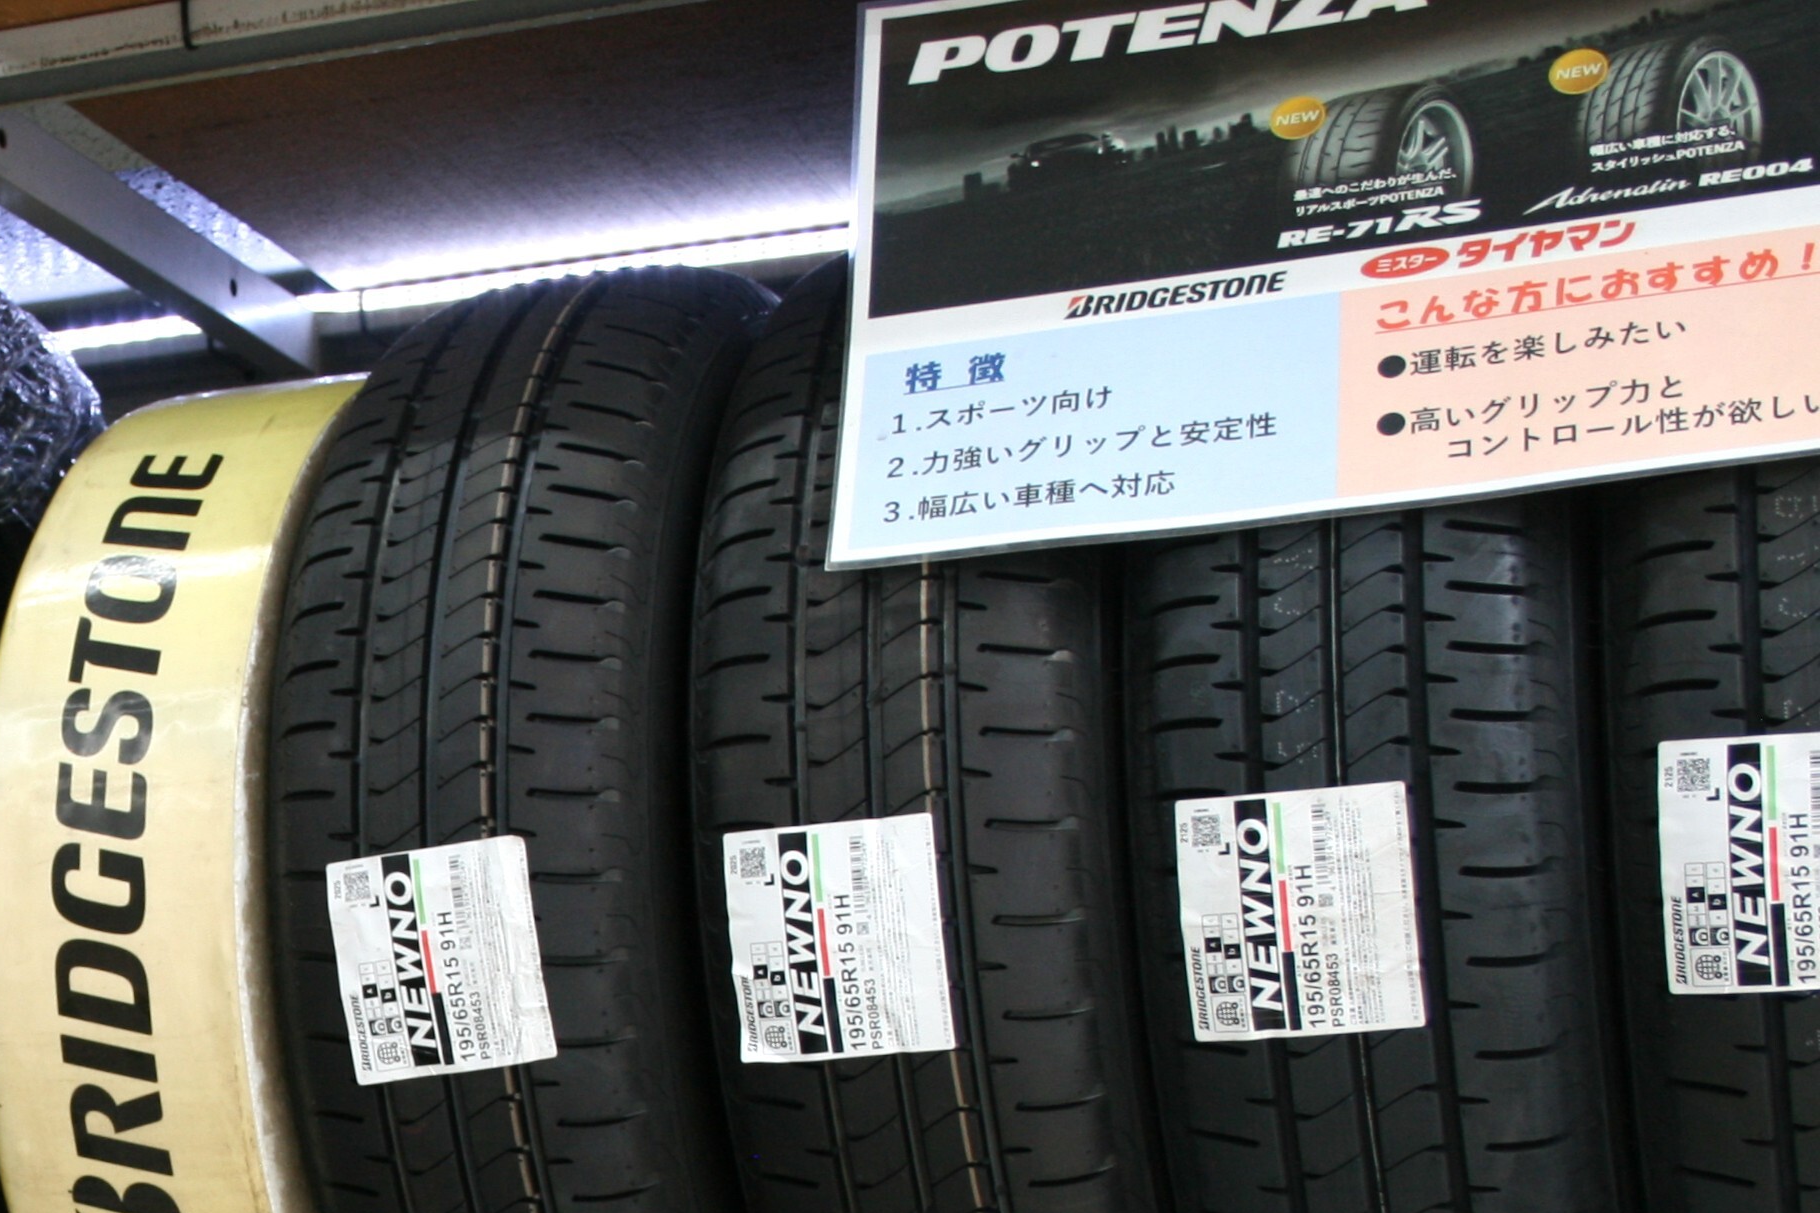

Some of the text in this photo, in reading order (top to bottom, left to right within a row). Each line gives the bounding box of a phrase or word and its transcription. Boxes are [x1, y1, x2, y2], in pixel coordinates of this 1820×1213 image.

[1555, 62, 1601, 82] NEW
[1276, 109, 1320, 127] NEW
[1276, 199, 1483, 249] RE-71RS
[1522, 157, 1815, 216] Adrenalin RE004
[1374, 219, 1637, 274] ミスター タイヤマン
[1064, 270, 1288, 320] BRIDGESTONE
[1728, 763, 1770, 966] NEWNO
[1788, 813, 1817, 984] 195/65R15 91H
[780, 850, 826, 1036] NEWNO
[1236, 818, 1283, 1012] NEWNO
[1295, 864, 1327, 1028] 195/65R15 91H
[1670, 896, 1688, 985] BRIDGESTONE
[384, 871, 439, 1049] NEWNO
[437, 911, 476, 1062] 195/65R15 91H
[833, 894, 867, 1051] 195/65R15 91H
[1190, 946, 1211, 1031] BRIDGESTONE
[349, 994, 372, 1071] BRIDGESTONE
[741, 976, 759, 1052] BRIDGESTONE
